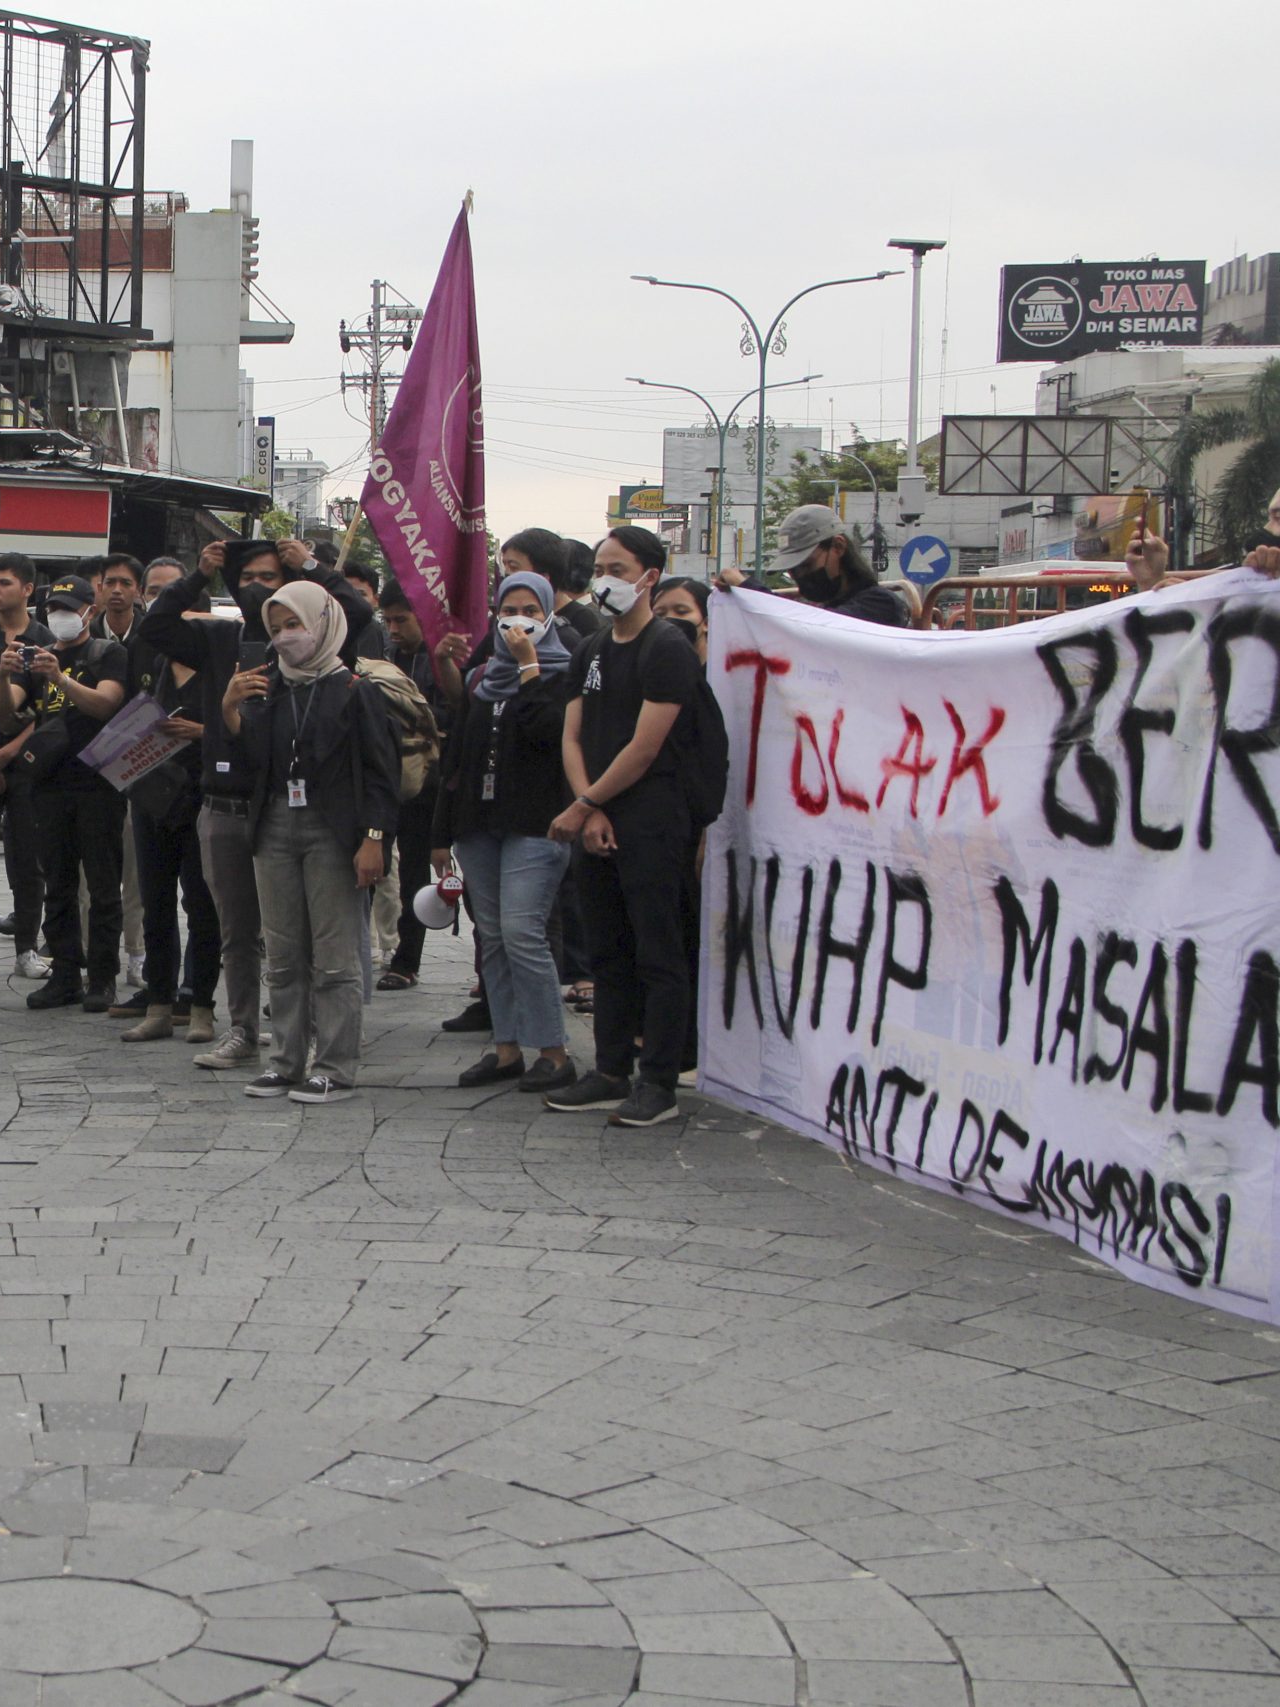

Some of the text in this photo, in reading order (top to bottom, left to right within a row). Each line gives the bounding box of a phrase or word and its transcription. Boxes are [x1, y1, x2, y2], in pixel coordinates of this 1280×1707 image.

[1104, 268, 1185, 281] TOKO MAS
[1088, 283, 1198, 314] JAWA
[1024, 304, 1065, 323] JAWA
[1086, 317, 1198, 333] D/H SEMAR
[258, 452, 267, 475] CCB
[726, 606, 1280, 855] TOLAK BER
[723, 848, 1280, 1130] KUHP MASALA
[825, 1062, 939, 1172] ANTI
